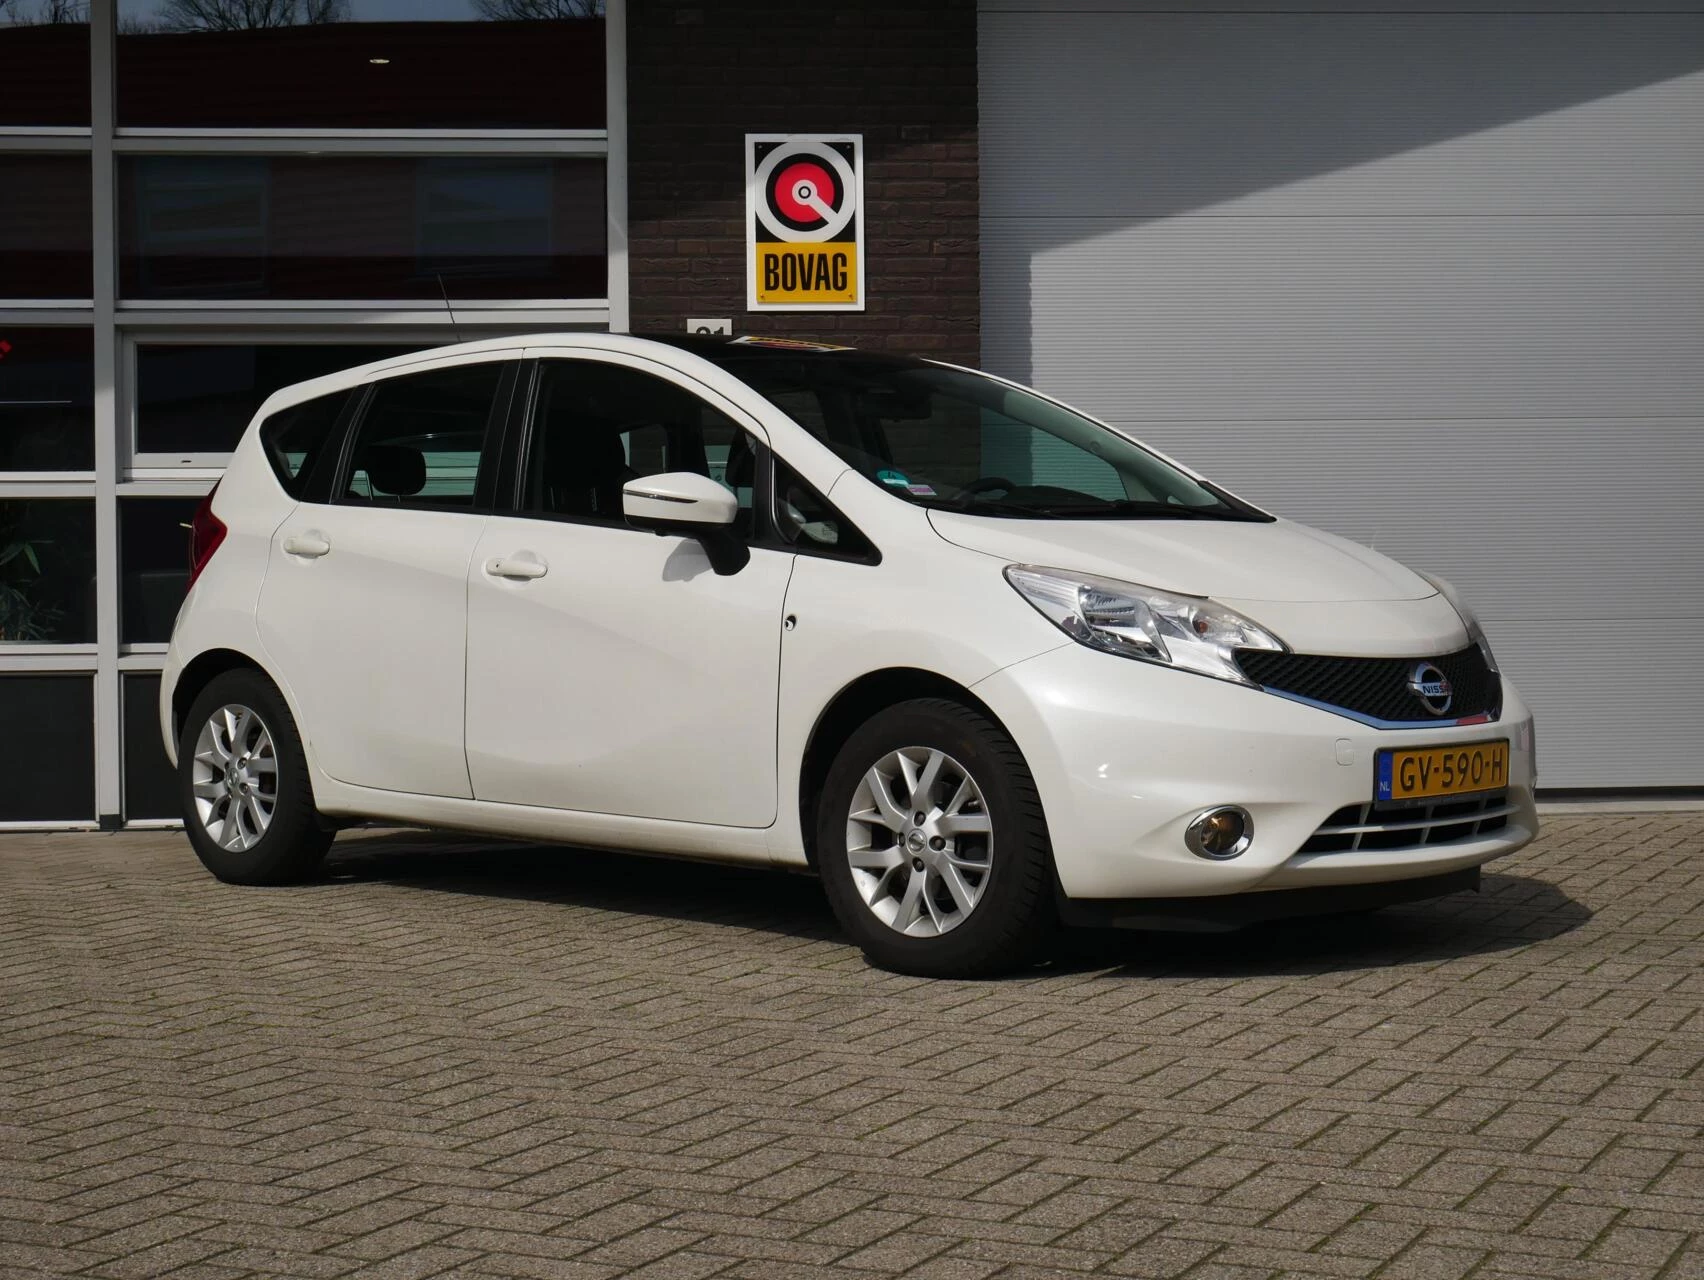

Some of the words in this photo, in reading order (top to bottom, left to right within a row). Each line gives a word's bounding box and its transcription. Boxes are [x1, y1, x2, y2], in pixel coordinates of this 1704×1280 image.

[764, 252, 848, 292] BOVAG
[1379, 781, 1391, 792] NL
[1400, 747, 1503, 792] GV-590-H
